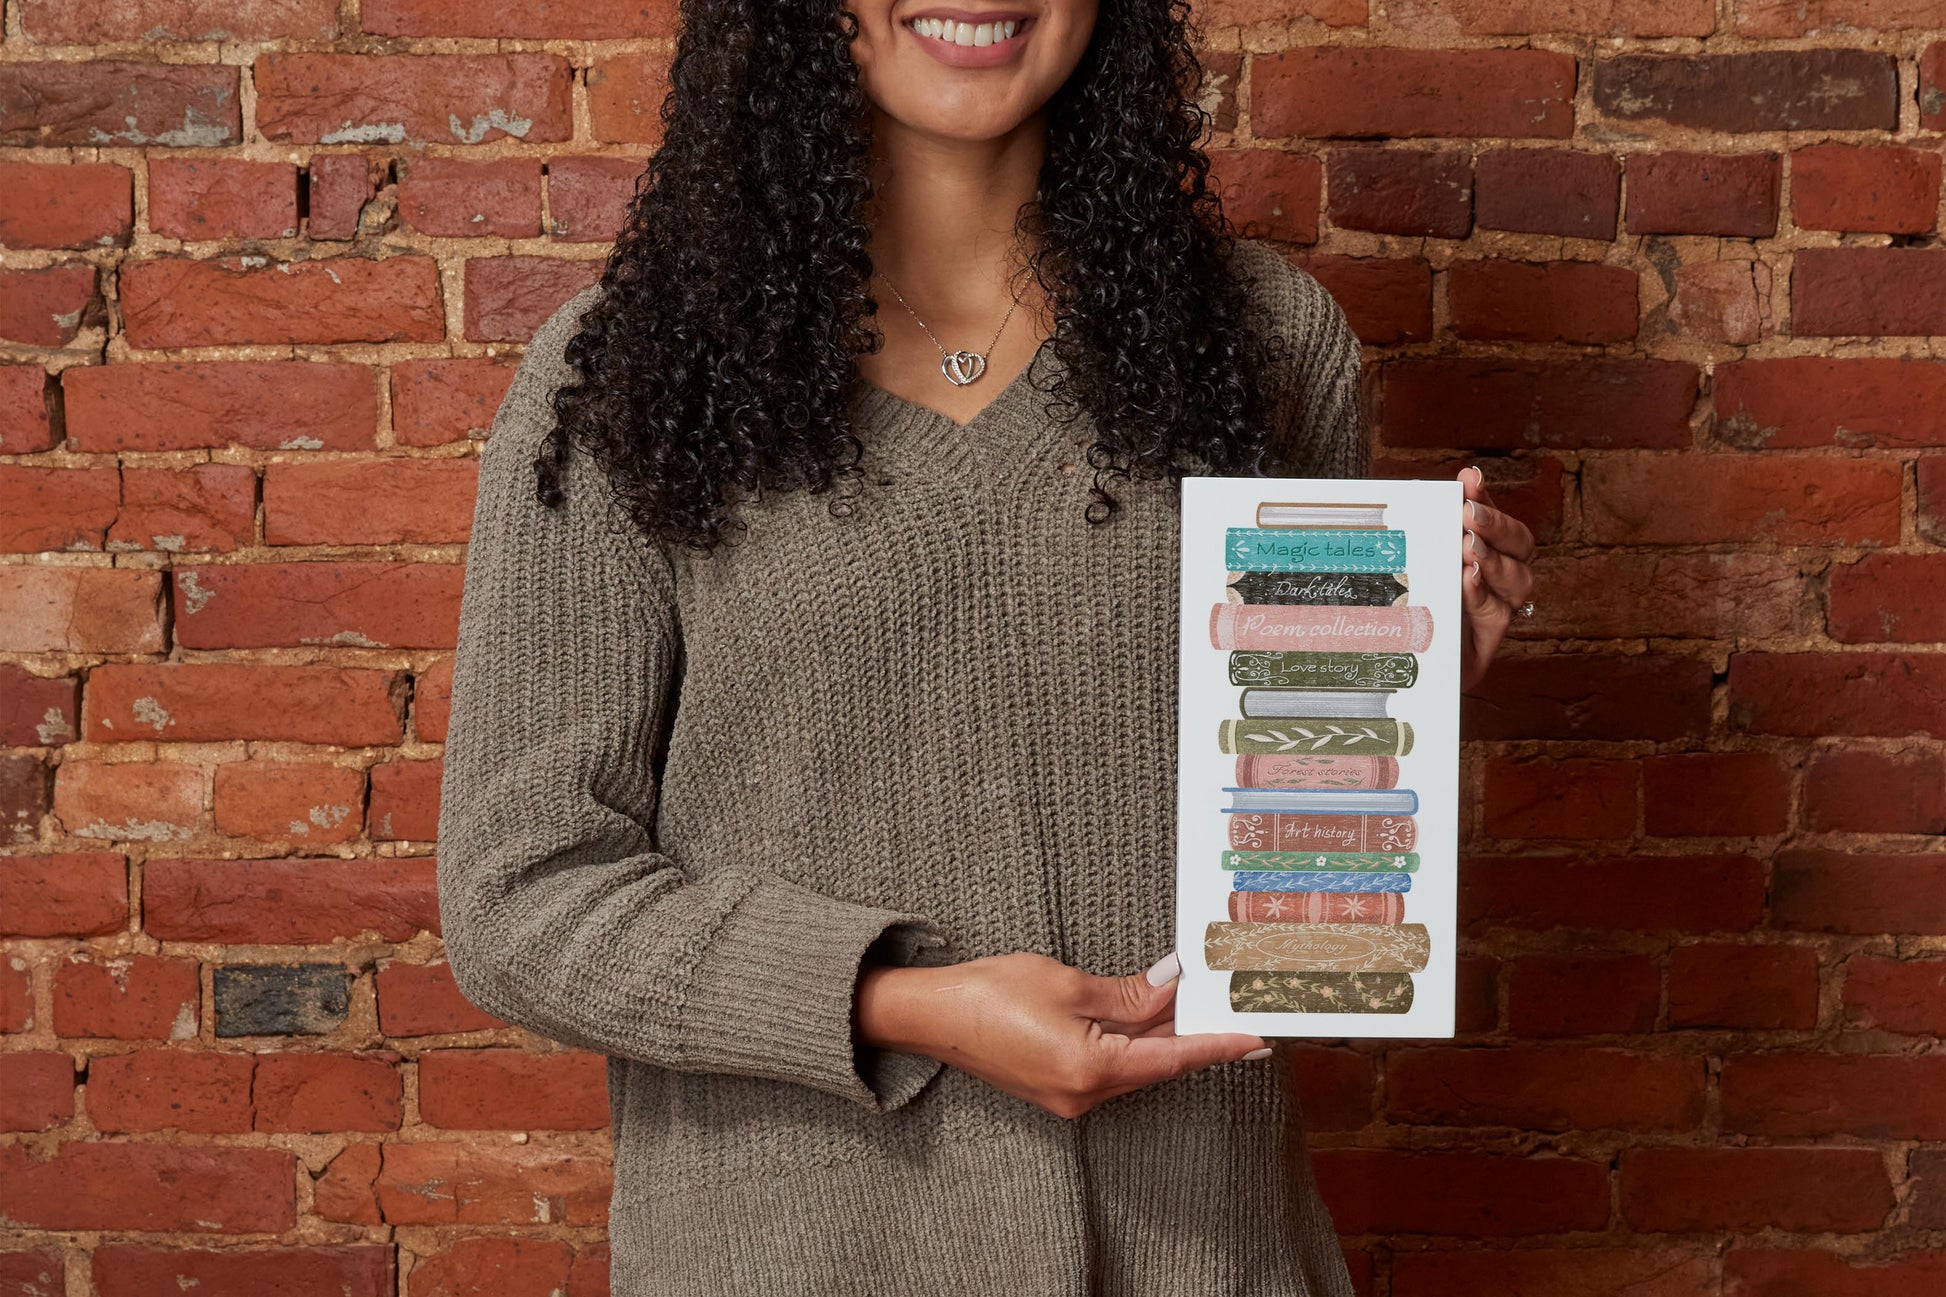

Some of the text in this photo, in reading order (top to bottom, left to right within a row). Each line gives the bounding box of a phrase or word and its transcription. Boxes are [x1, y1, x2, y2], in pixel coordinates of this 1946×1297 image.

[1256, 539, 1376, 563] Magic tales
[1274, 575, 1358, 600] Dark tales
[1242, 614, 1402, 638] Poem collection
[1280, 660, 1359, 680] Love story
[1266, 762, 1363, 777] Forest stories
[1283, 821, 1356, 847] Art history
[1274, 938, 1348, 954] Mythology
